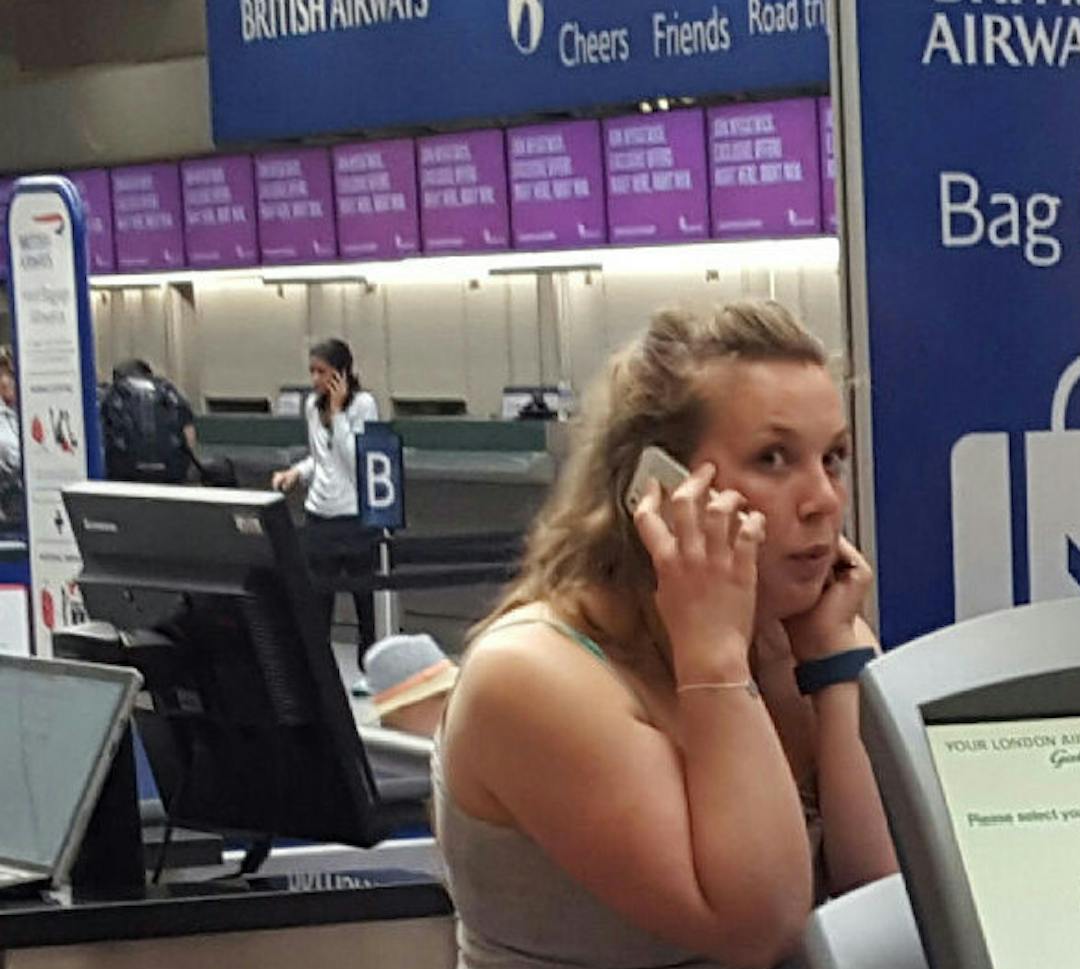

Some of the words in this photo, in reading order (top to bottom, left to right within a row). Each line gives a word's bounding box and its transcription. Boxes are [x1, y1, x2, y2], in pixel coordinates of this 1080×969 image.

[241, 0, 326, 41] BRITISH
[653, 6, 731, 58] Friends
[749, 0, 799, 34] Road
[559, 22, 630, 66] Cheers
[940, 171, 1062, 267] Bag
[366, 451, 395, 508] B
[944, 740, 987, 753] YOUR
[991, 736, 1056, 751] LONDON
[967, 812, 1013, 827] Please
[1017, 809, 1058, 823] select
